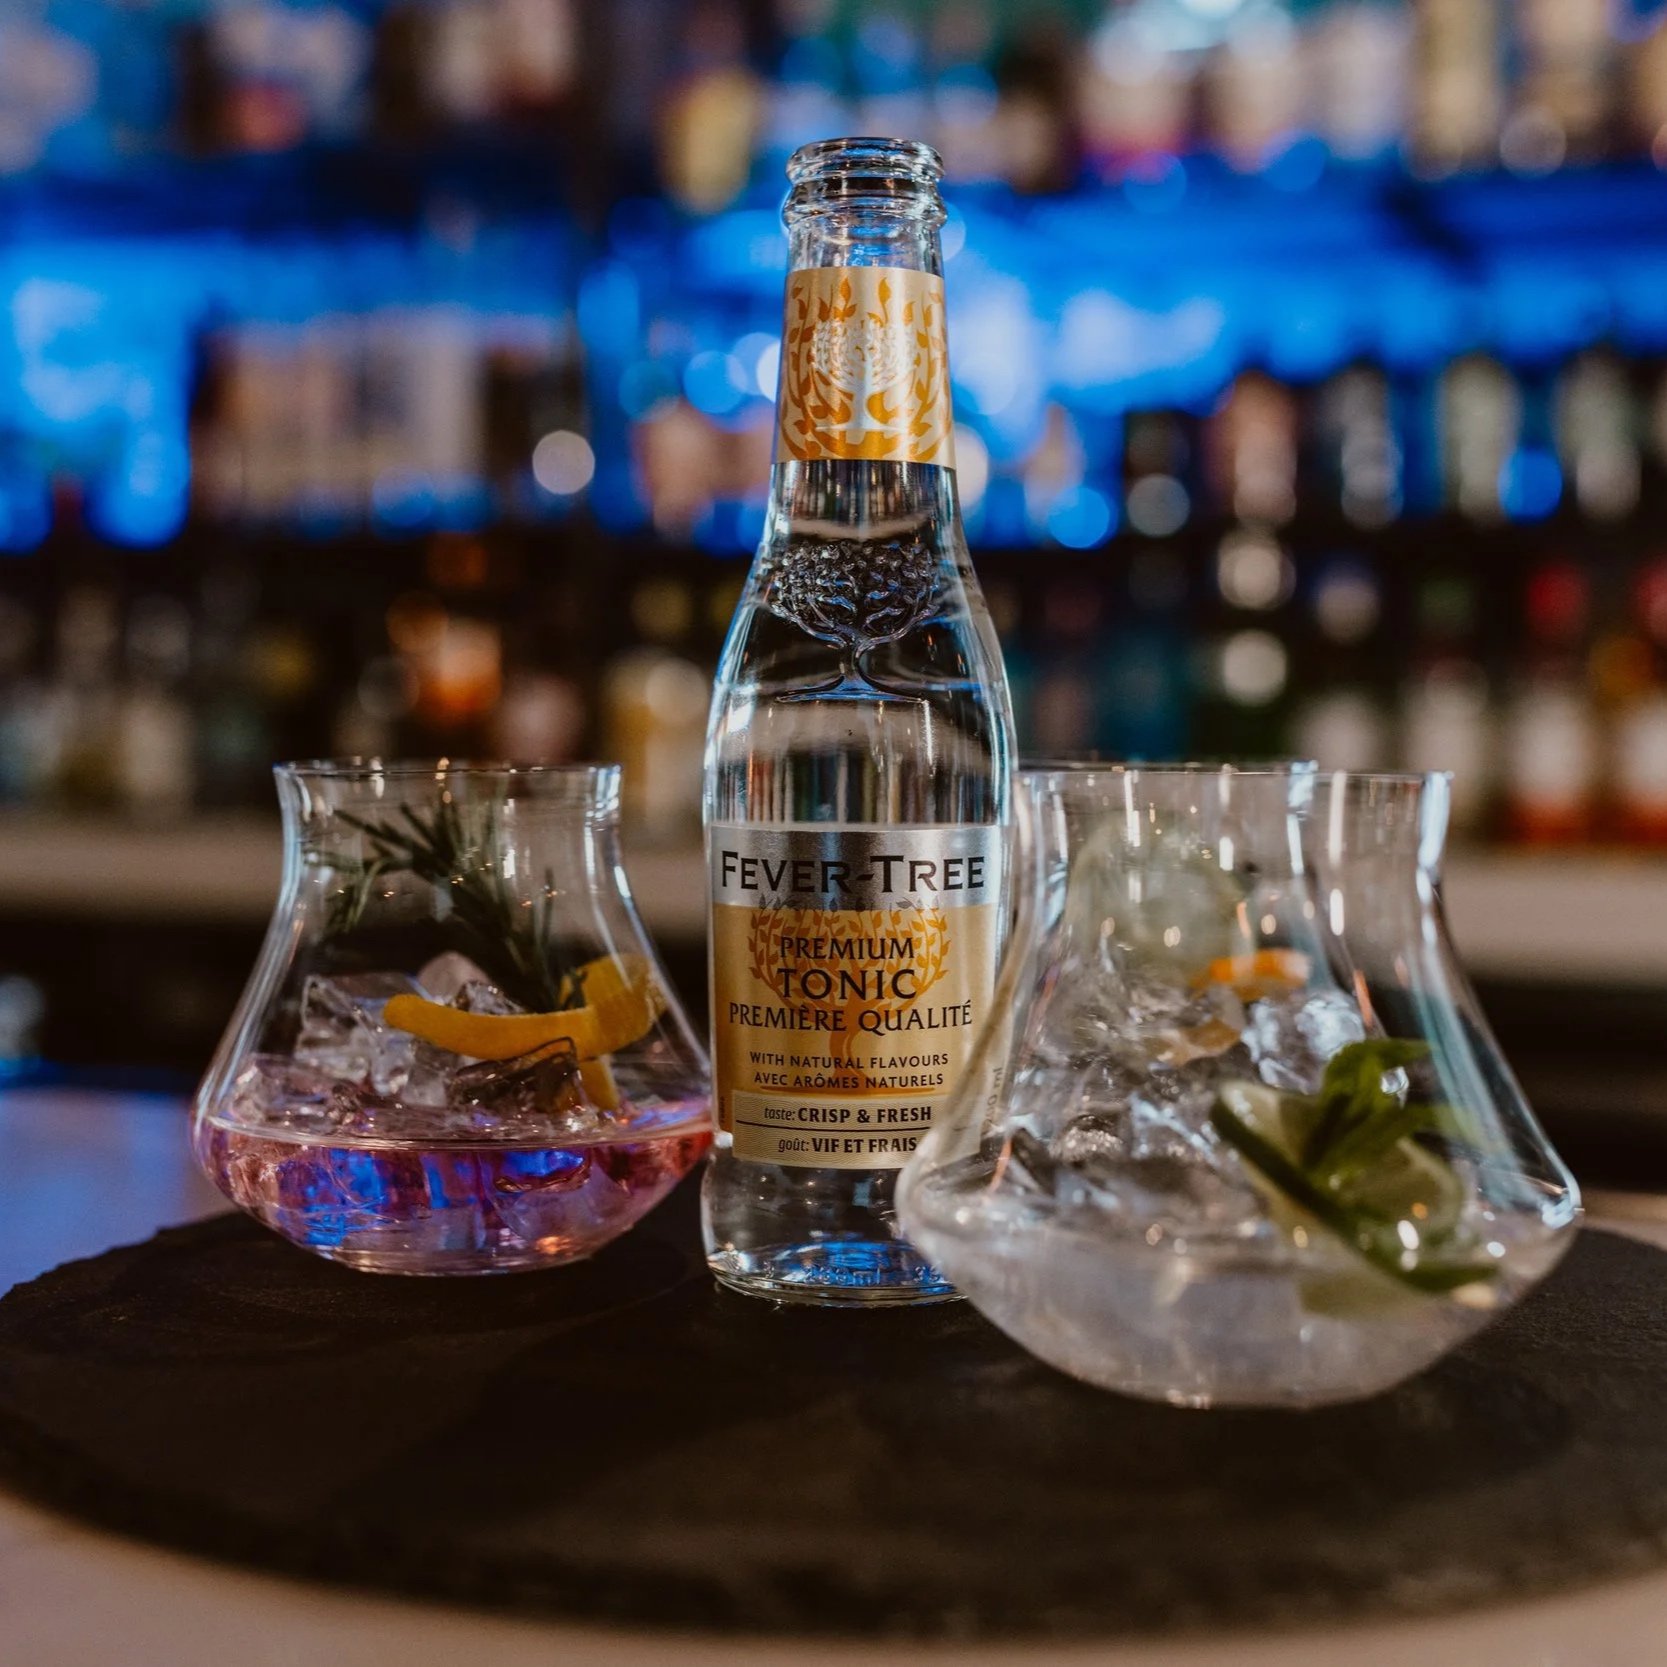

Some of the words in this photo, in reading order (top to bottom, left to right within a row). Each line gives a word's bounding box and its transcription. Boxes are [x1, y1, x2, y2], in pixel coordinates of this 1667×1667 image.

[721, 850, 985, 893] FEVER-TREE
[780, 937, 915, 960] PREMIUM
[777, 968, 916, 1000] TONIC
[729, 1002, 847, 1031] PREMIÈRE
[858, 1000, 973, 1036] QUALITÉ
[750, 1051, 784, 1066] WITH
[790, 1056, 864, 1069] NATURAL
[870, 1053, 949, 1069] FLAVOURS
[754, 1072, 788, 1086] AVEC
[794, 1073, 859, 1088] ARÔMES
[865, 1073, 944, 1088] NATURELS
[764, 1107, 796, 1121] taste:
[798, 1107, 850, 1123] CRISP
[857, 1109, 870, 1123] &
[877, 1106, 932, 1123] FRESH
[778, 1137, 810, 1153] goût:
[812, 1138, 839, 1153] VIF
[844, 1139, 864, 1153] ET
[868, 1137, 917, 1153] FRAIS
